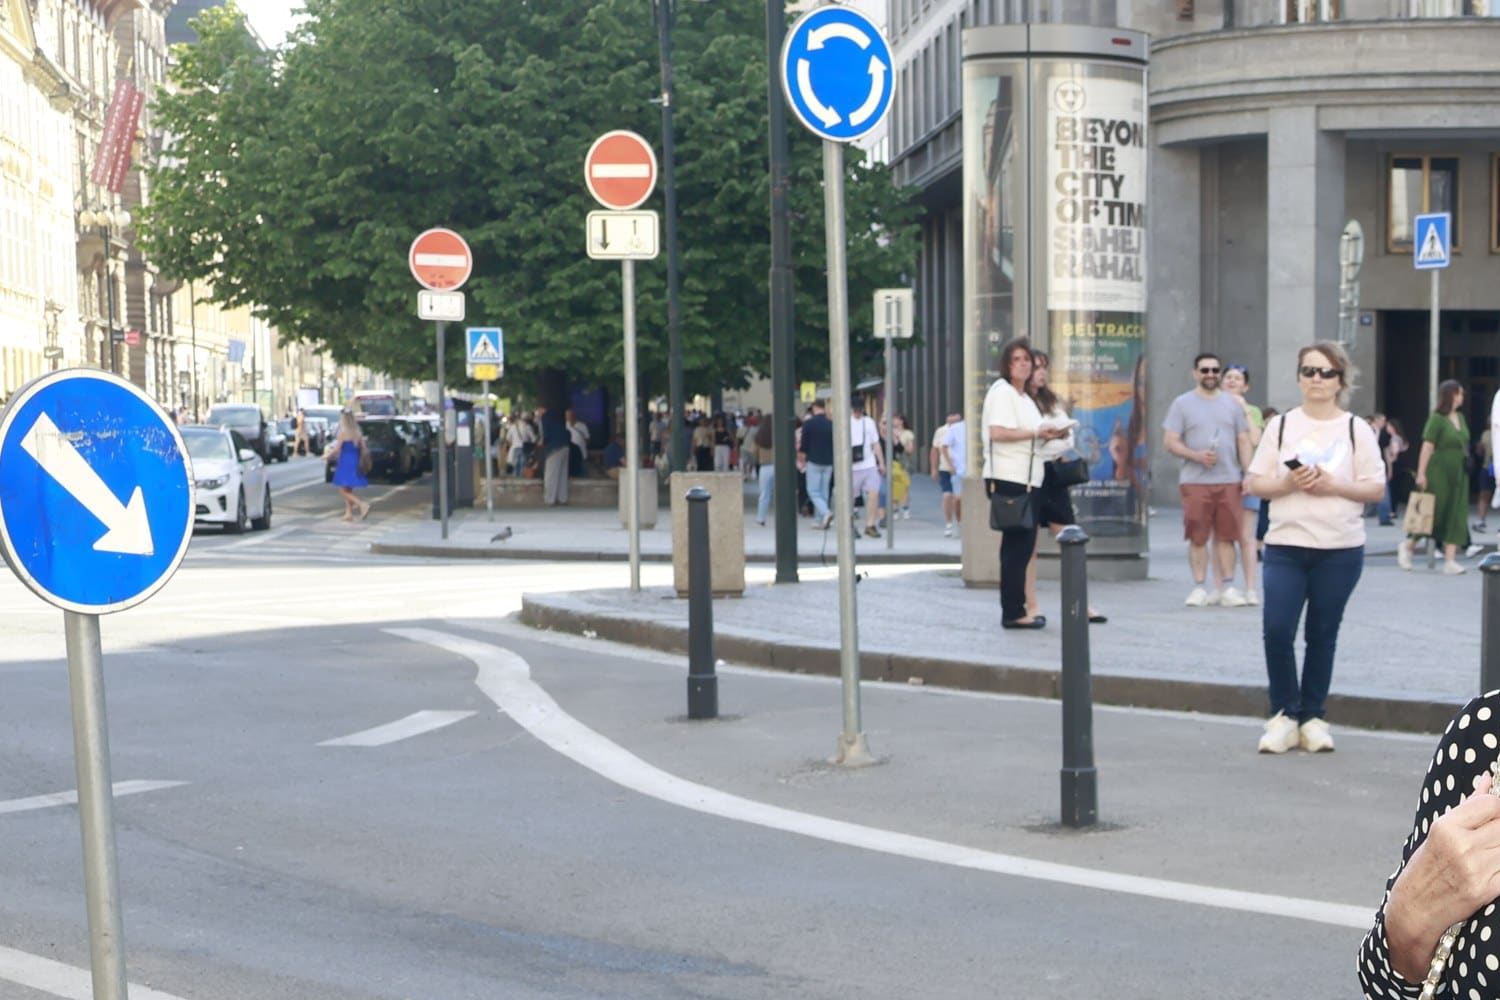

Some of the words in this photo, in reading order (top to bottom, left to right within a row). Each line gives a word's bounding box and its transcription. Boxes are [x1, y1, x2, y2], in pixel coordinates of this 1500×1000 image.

[1055, 143, 1116, 171] THE
[1055, 171, 1124, 199] CITY
[1055, 198, 1100, 224] OF
